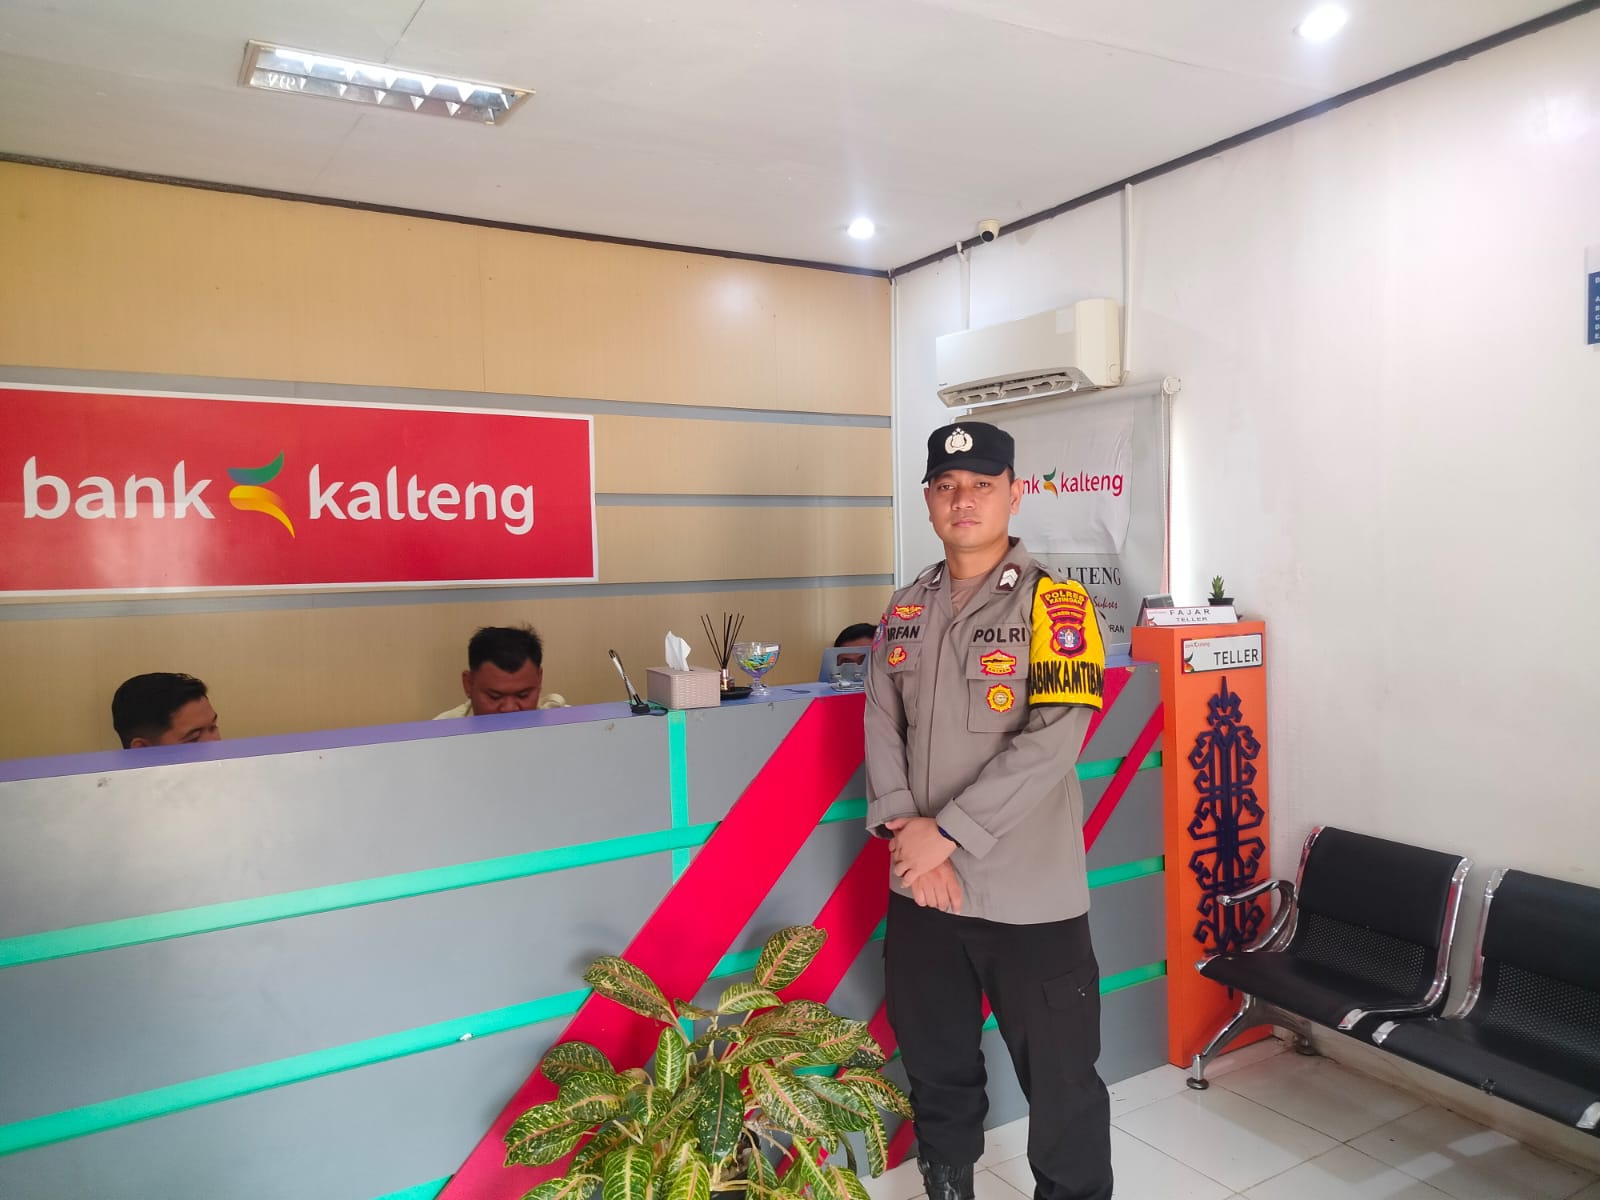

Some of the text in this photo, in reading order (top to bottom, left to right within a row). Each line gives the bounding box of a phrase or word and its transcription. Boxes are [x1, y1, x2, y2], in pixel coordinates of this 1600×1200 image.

[1022, 470, 1124, 497] nk kalteng
[23, 456, 535, 536] bank kalteng
[1044, 590, 1085, 602] POLRES
[1169, 608, 1211, 616] FAJAR
[887, 626, 920, 641] IRFAN
[973, 627, 1027, 644] POLRI
[1108, 624, 1125, 633] RAN
[1213, 648, 1259, 666] TELLER
